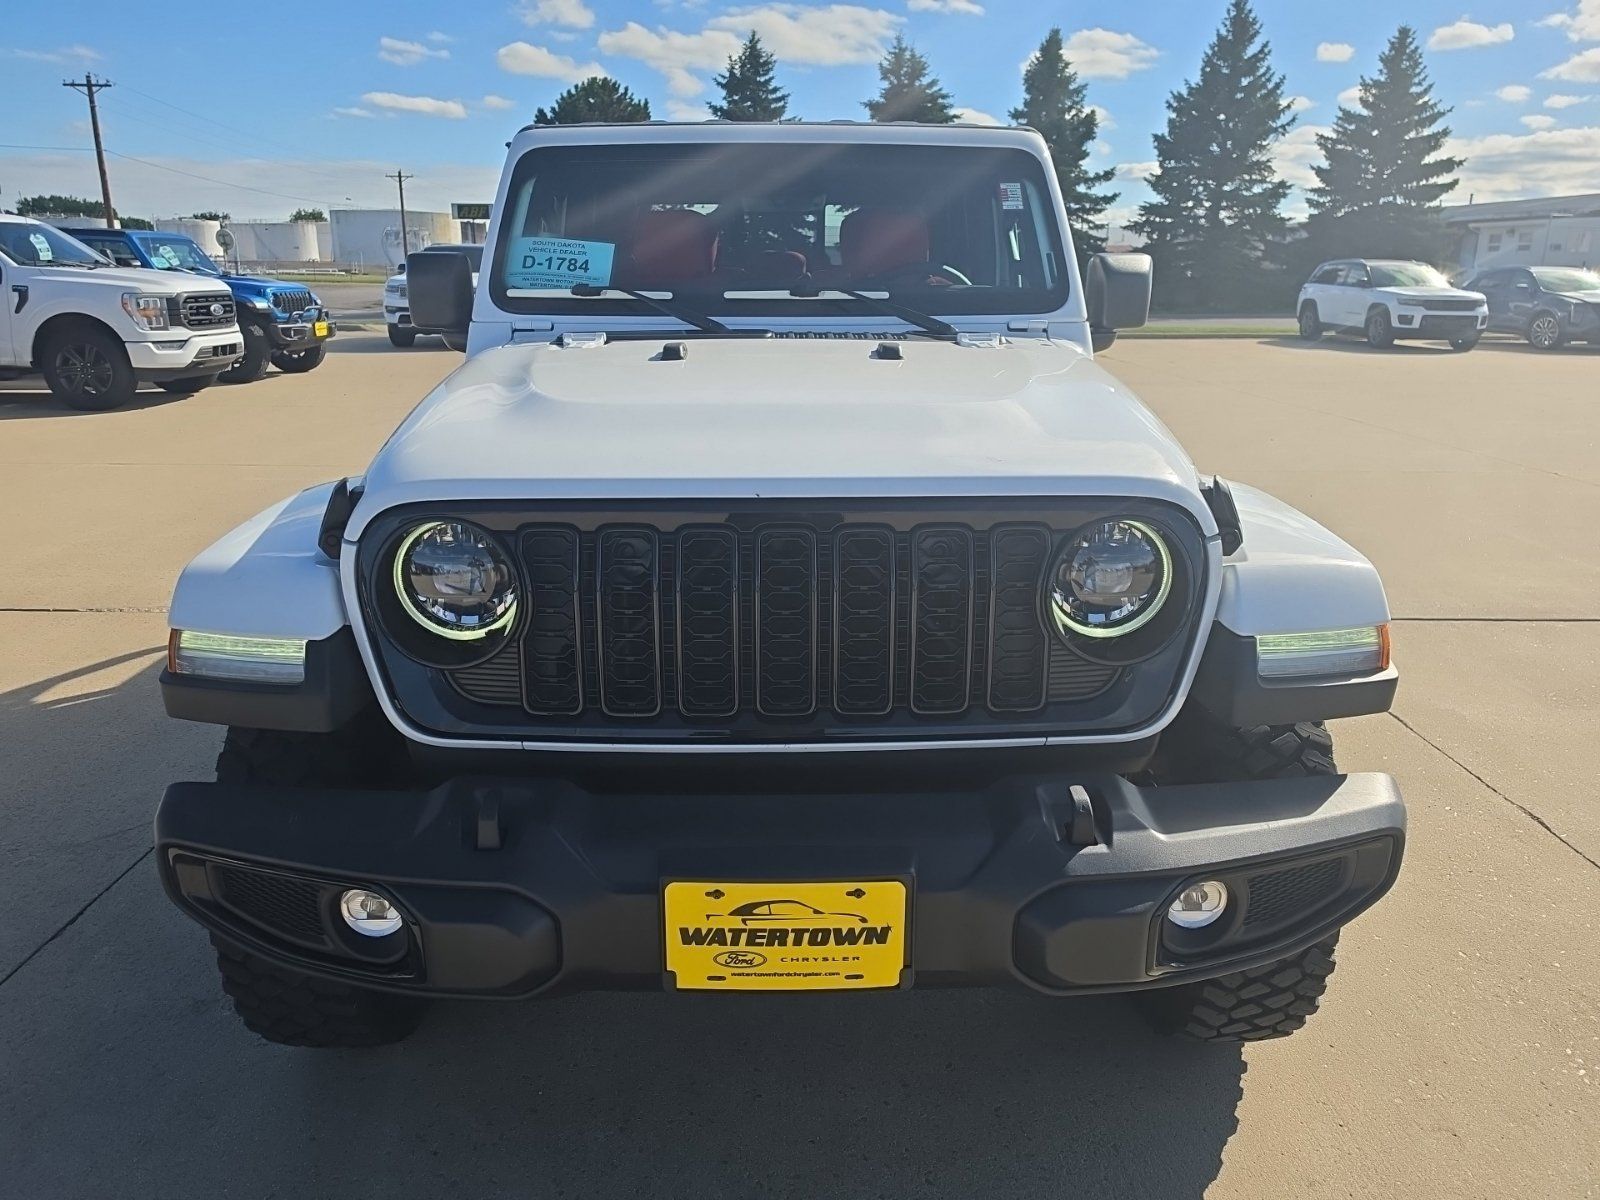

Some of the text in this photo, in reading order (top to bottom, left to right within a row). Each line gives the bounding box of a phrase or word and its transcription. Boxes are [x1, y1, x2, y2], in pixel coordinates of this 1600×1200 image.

[459, 206, 487, 217] ABF
[528, 246, 558, 254] VEHICLE
[522, 255, 590, 273] D-1784
[679, 926, 891, 946] WATERTOWN
[724, 952, 861, 966] Ford CHRYSLER
[731, 970, 841, 978] watertownfordchrysler.com
